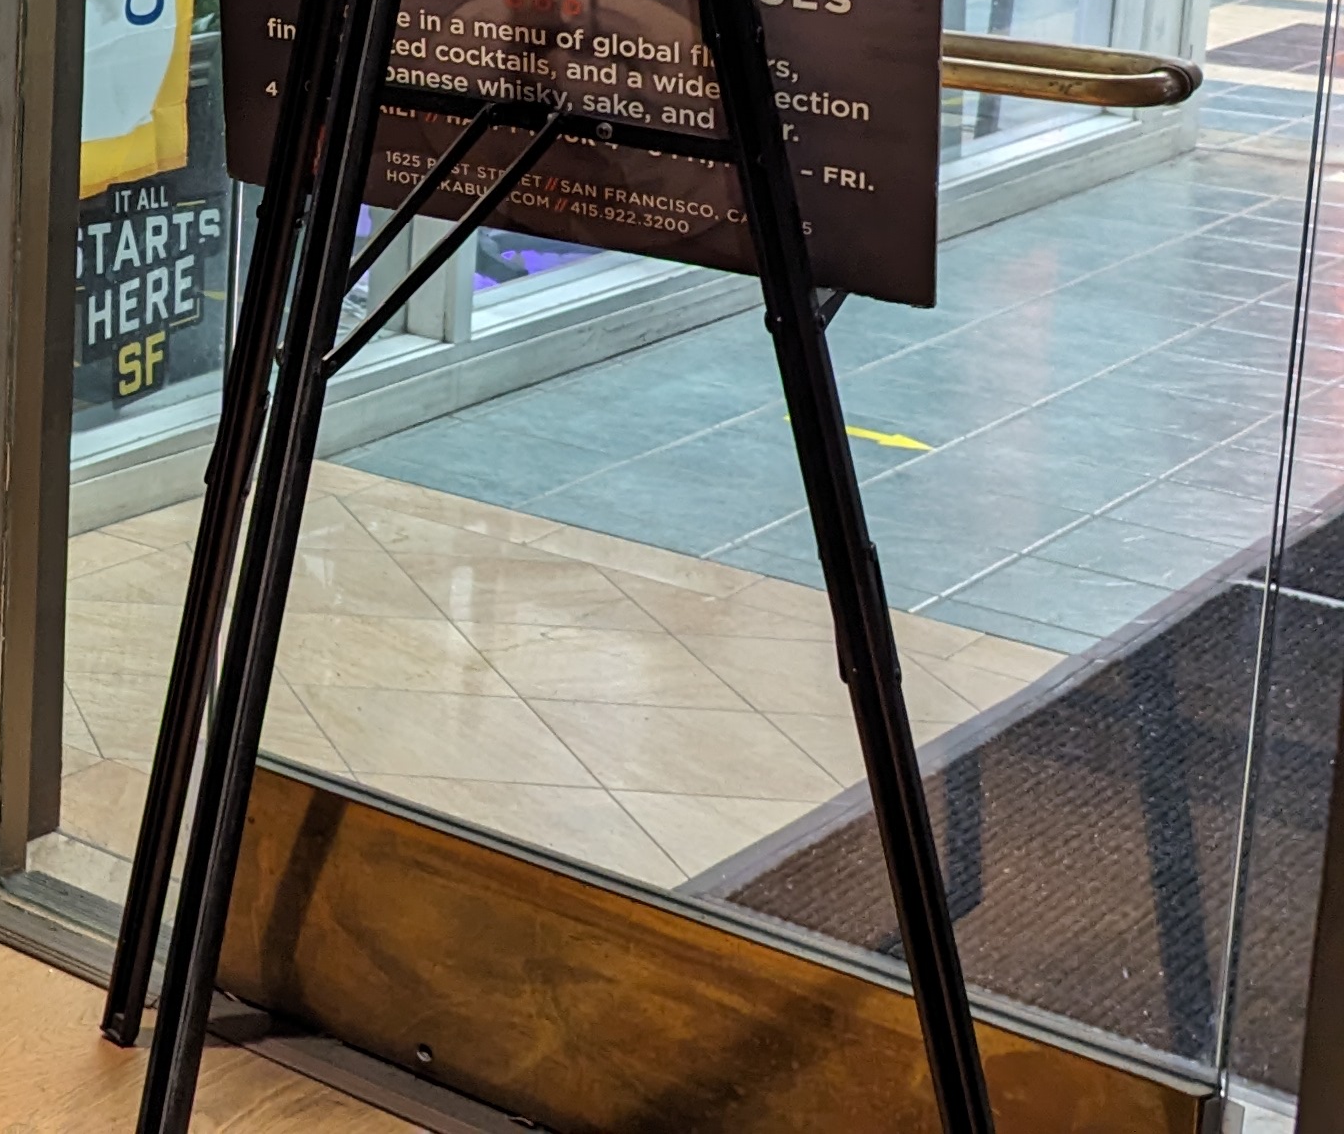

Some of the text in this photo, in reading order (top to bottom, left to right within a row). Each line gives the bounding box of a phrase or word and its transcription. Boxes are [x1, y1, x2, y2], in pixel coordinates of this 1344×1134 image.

[419, 9, 442, 32] in
[449, 18, 465, 36] a
[473, 20, 547, 47] menu
[556, 28, 585, 50] of
[592, 32, 681, 64] global
[435, 44, 558, 80] cocktails,
[565, 61, 618, 86] and
[626, 70, 644, 89] a
[653, 73, 722, 100] wide
[774, 90, 870, 122] ection
[477, 76, 574, 112] whisky,
[582, 92, 652, 124] sake,
[661, 104, 716, 130] and
[115, 185, 169, 214] IT ALL
[385, 150, 421, 168] 1625
[427, 157, 471, 177] PST
[561, 179, 598, 199] SAN
[823, 165, 876, 192] FRI.
[570, 201, 691, 235] 415.922.3200
[88, 254, 195, 346] HERE
[118, 330, 166, 397] SF
